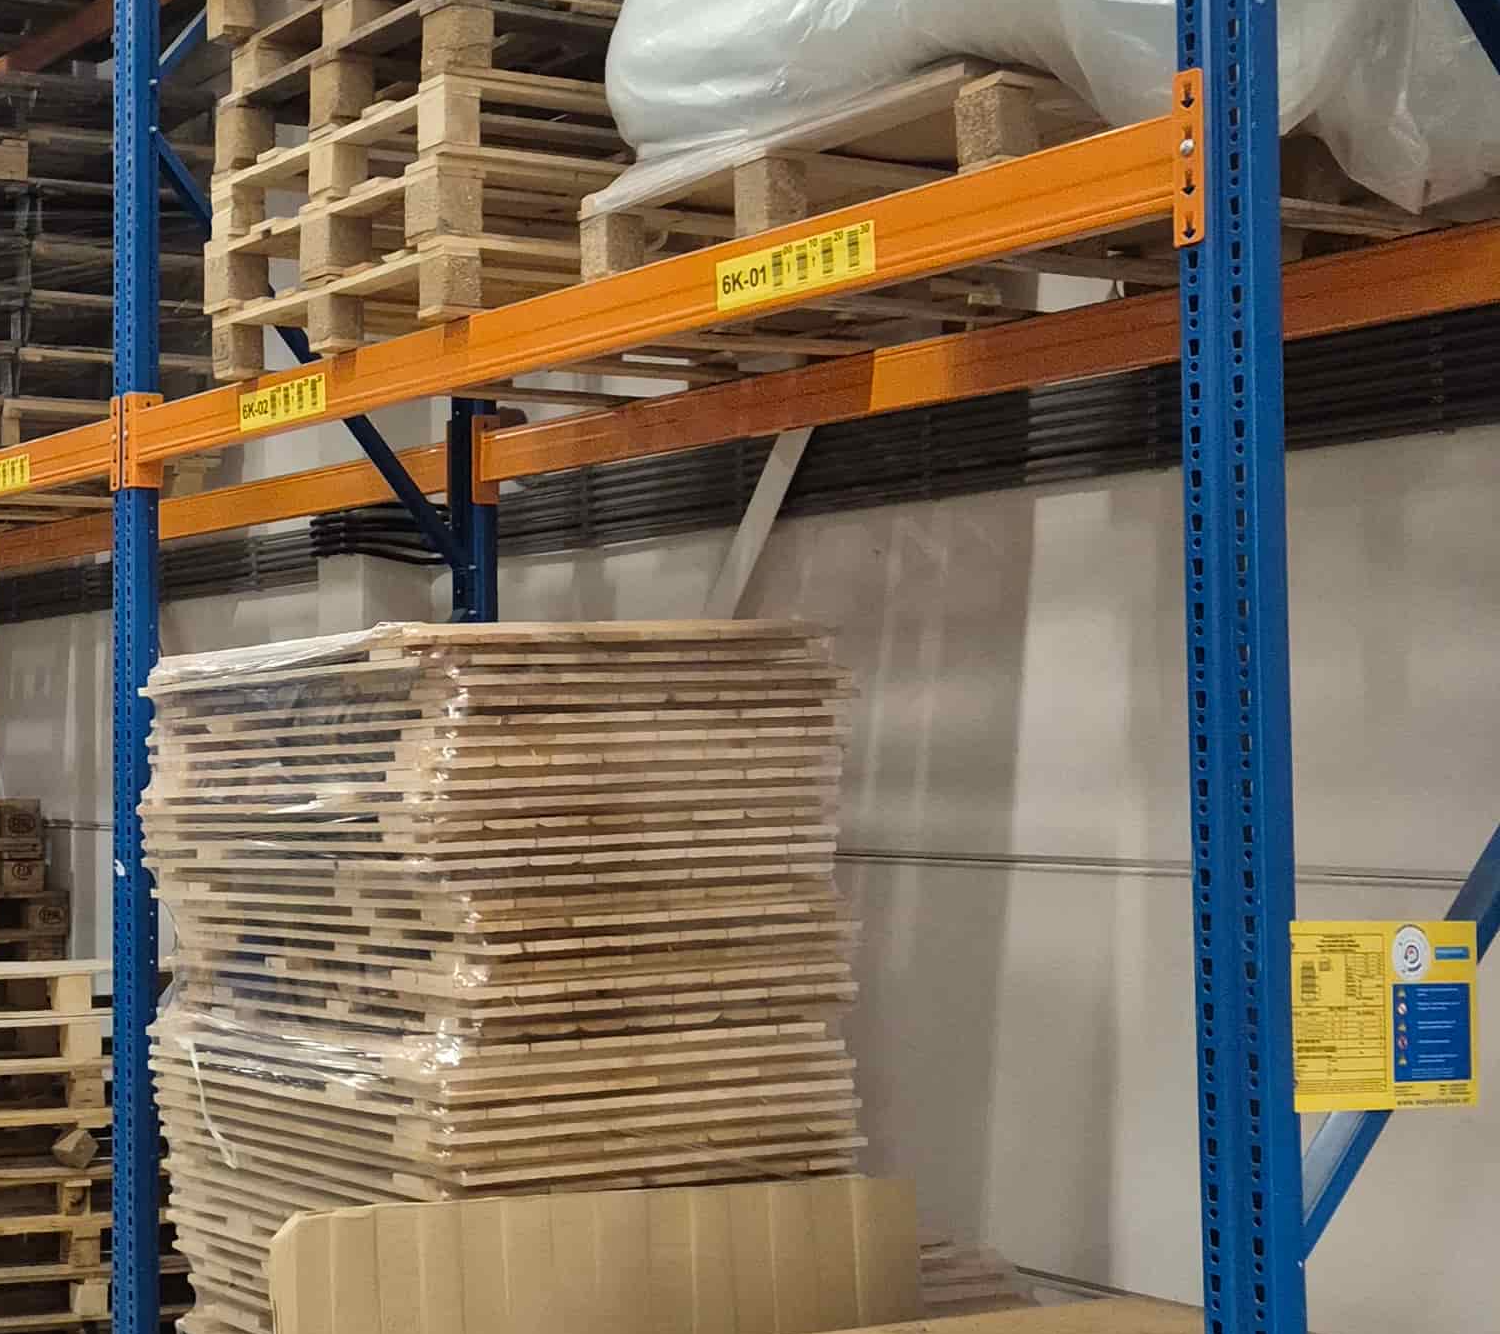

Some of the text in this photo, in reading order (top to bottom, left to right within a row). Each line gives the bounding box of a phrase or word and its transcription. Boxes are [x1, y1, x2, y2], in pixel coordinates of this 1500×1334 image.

[721, 264, 767, 295] 6K-01
[833, 230, 844, 243] 20
[859, 223, 870, 234] 30
[242, 399, 269, 420] 6K-02
